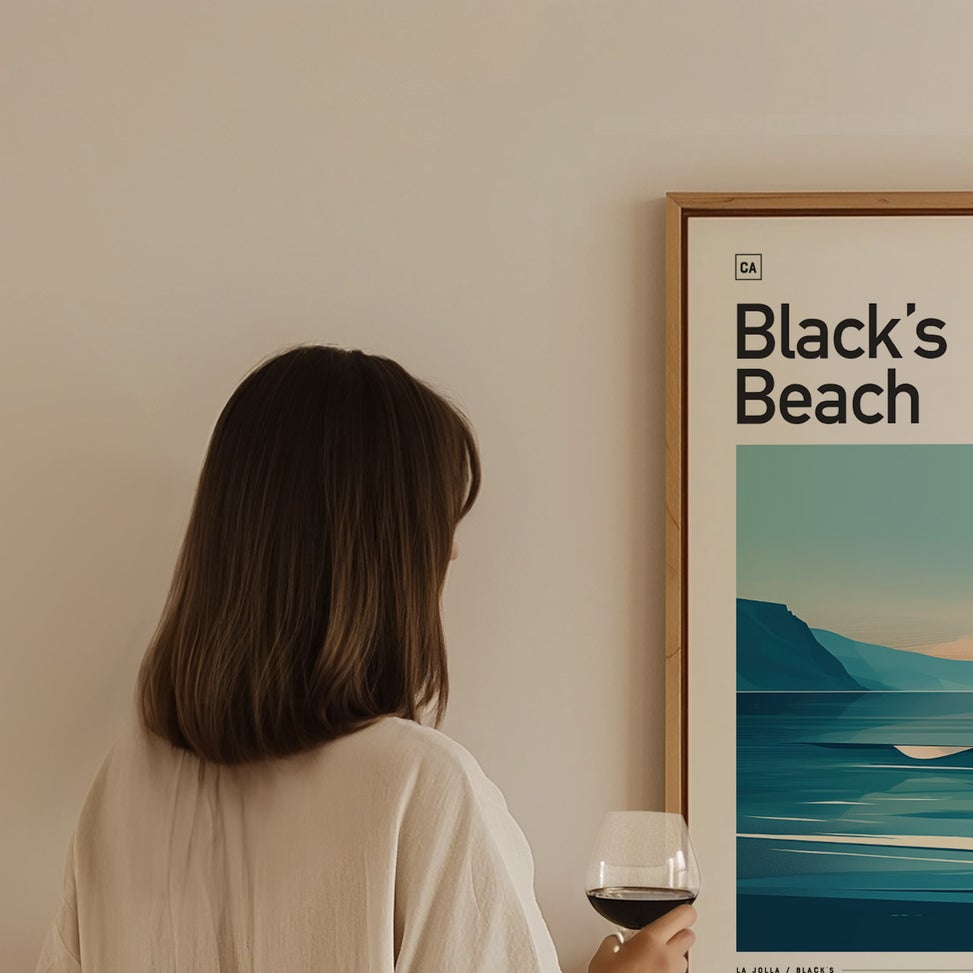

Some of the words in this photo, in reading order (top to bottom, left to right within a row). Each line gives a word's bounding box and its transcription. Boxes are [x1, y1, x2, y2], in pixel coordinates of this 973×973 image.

[740, 261, 758, 274] CA
[736, 302, 948, 360] Black's
[736, 367, 920, 425] Beach
